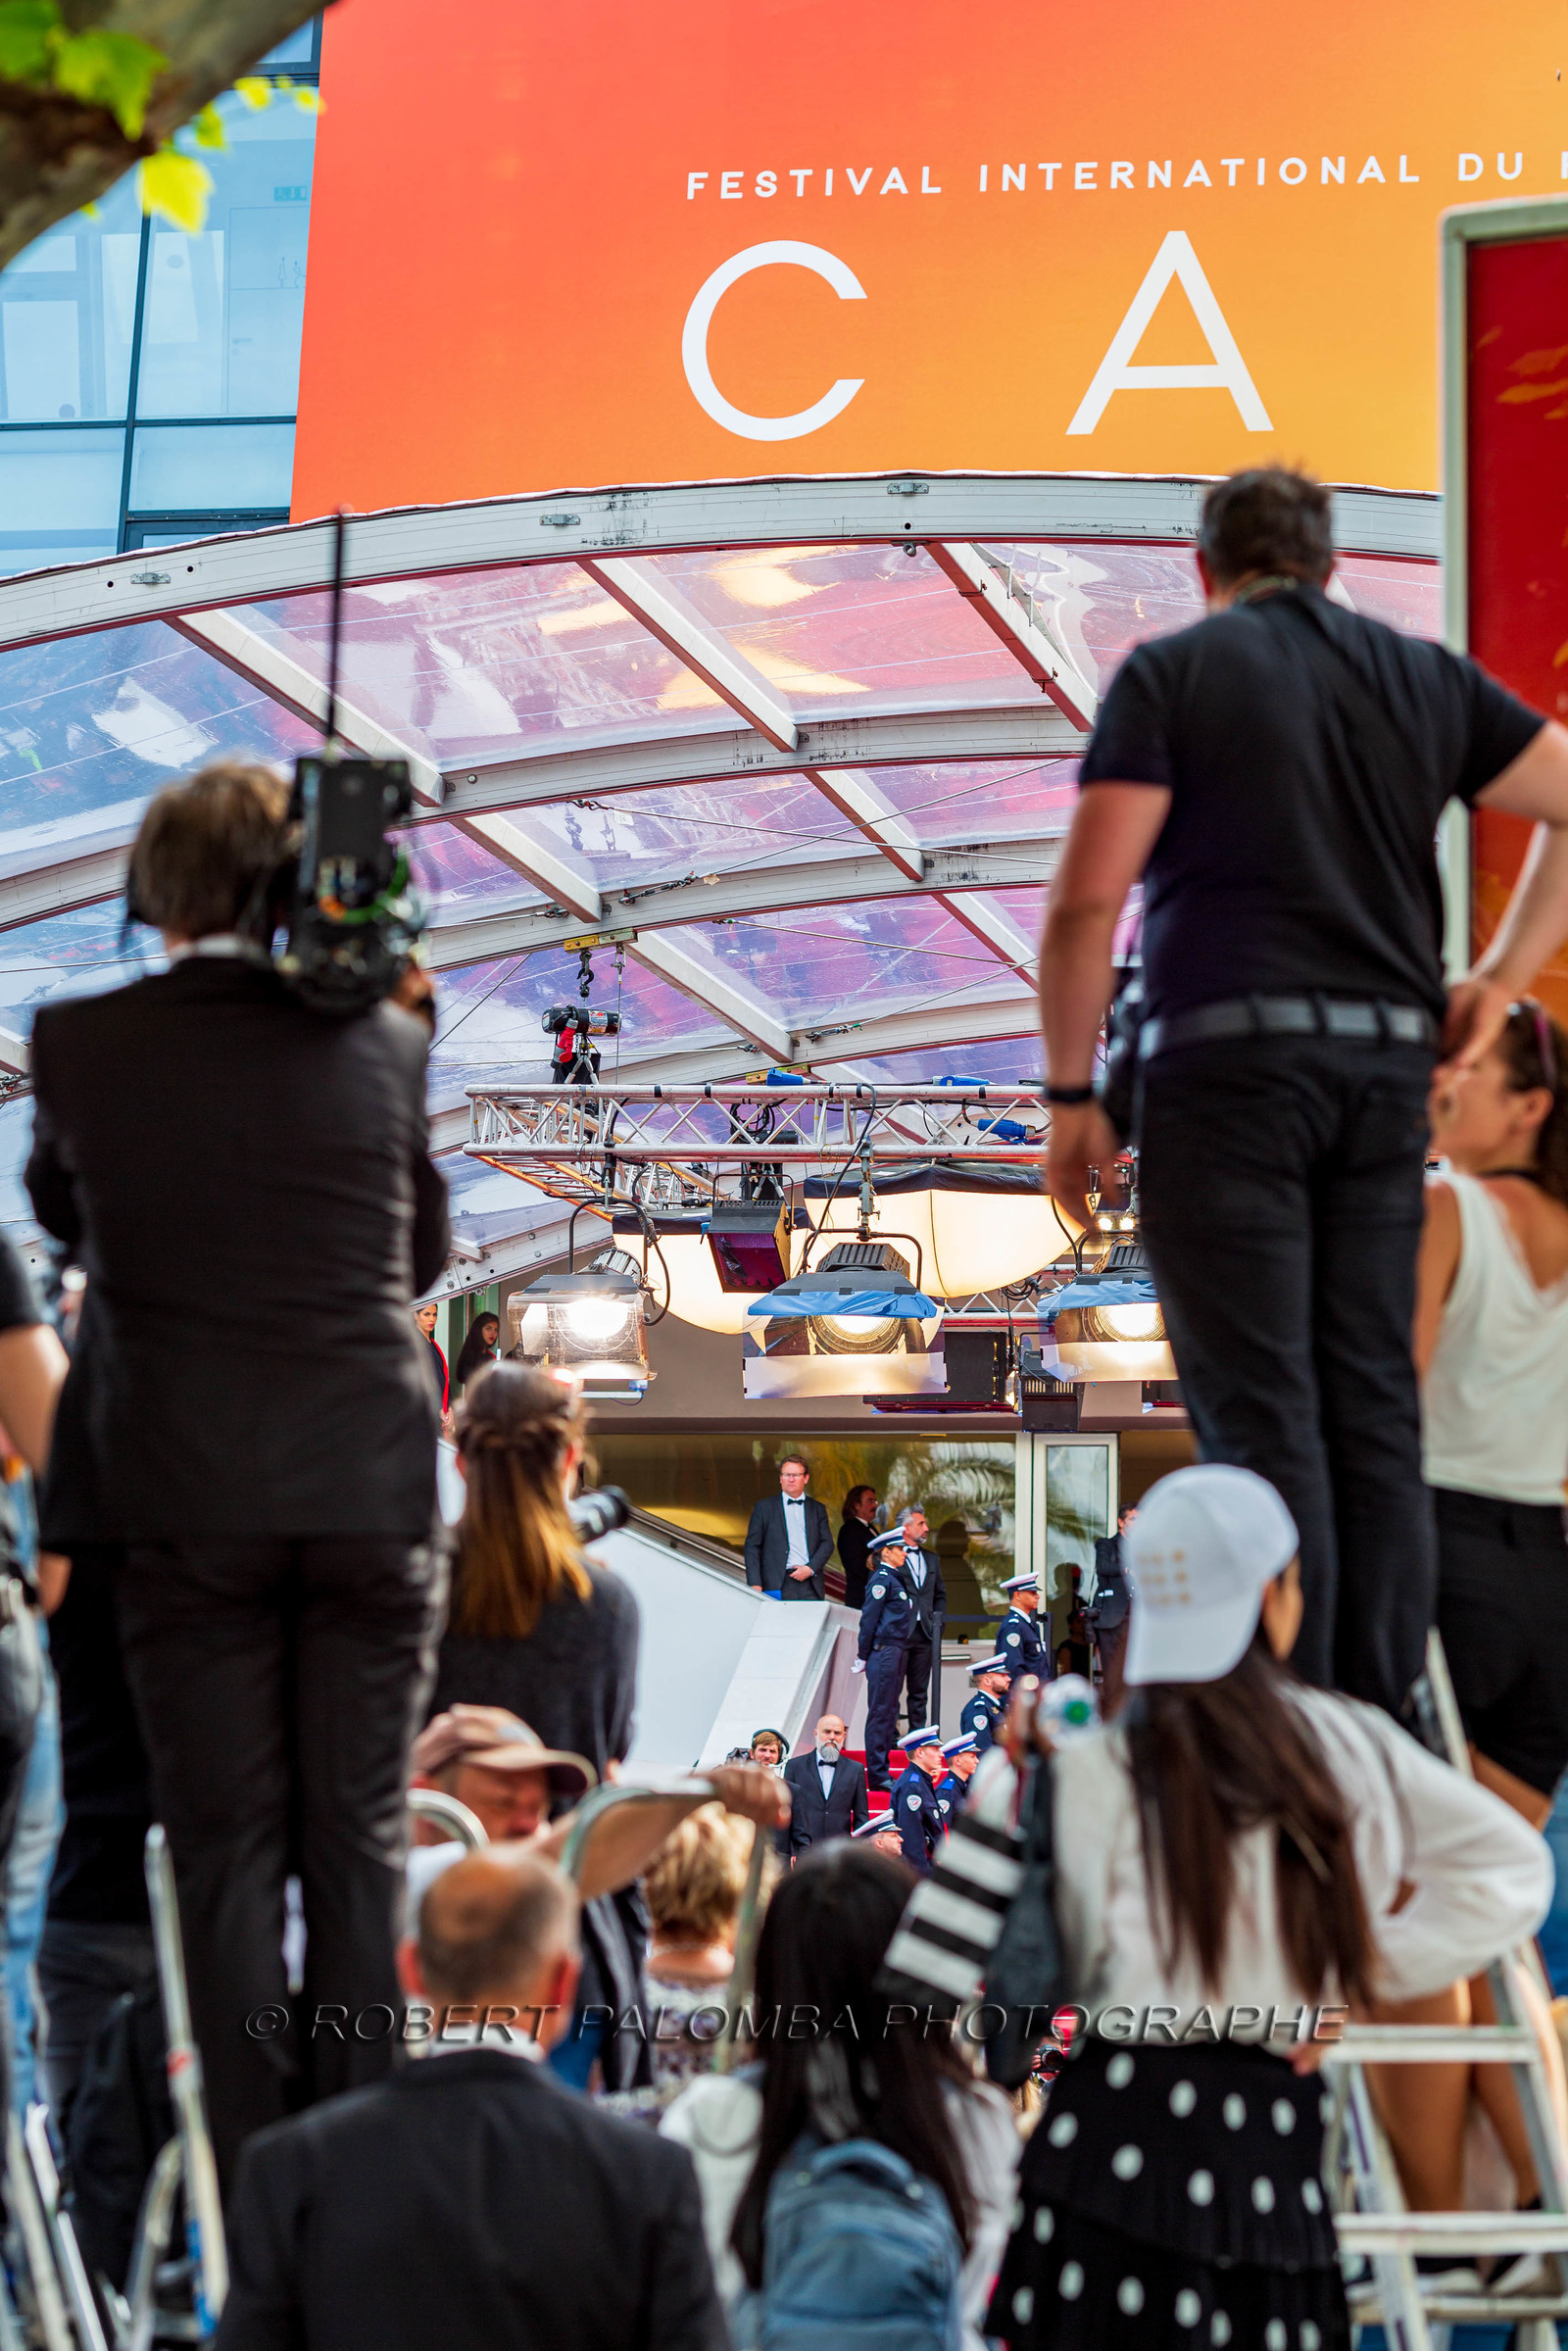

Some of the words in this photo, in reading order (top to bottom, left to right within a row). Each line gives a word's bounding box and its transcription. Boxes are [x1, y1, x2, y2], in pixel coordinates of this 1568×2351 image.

[686, 166, 942, 200] FESTIVAL
[979, 154, 1420, 192] INTERNATIONAL
[1457, 151, 1523, 181] DU
